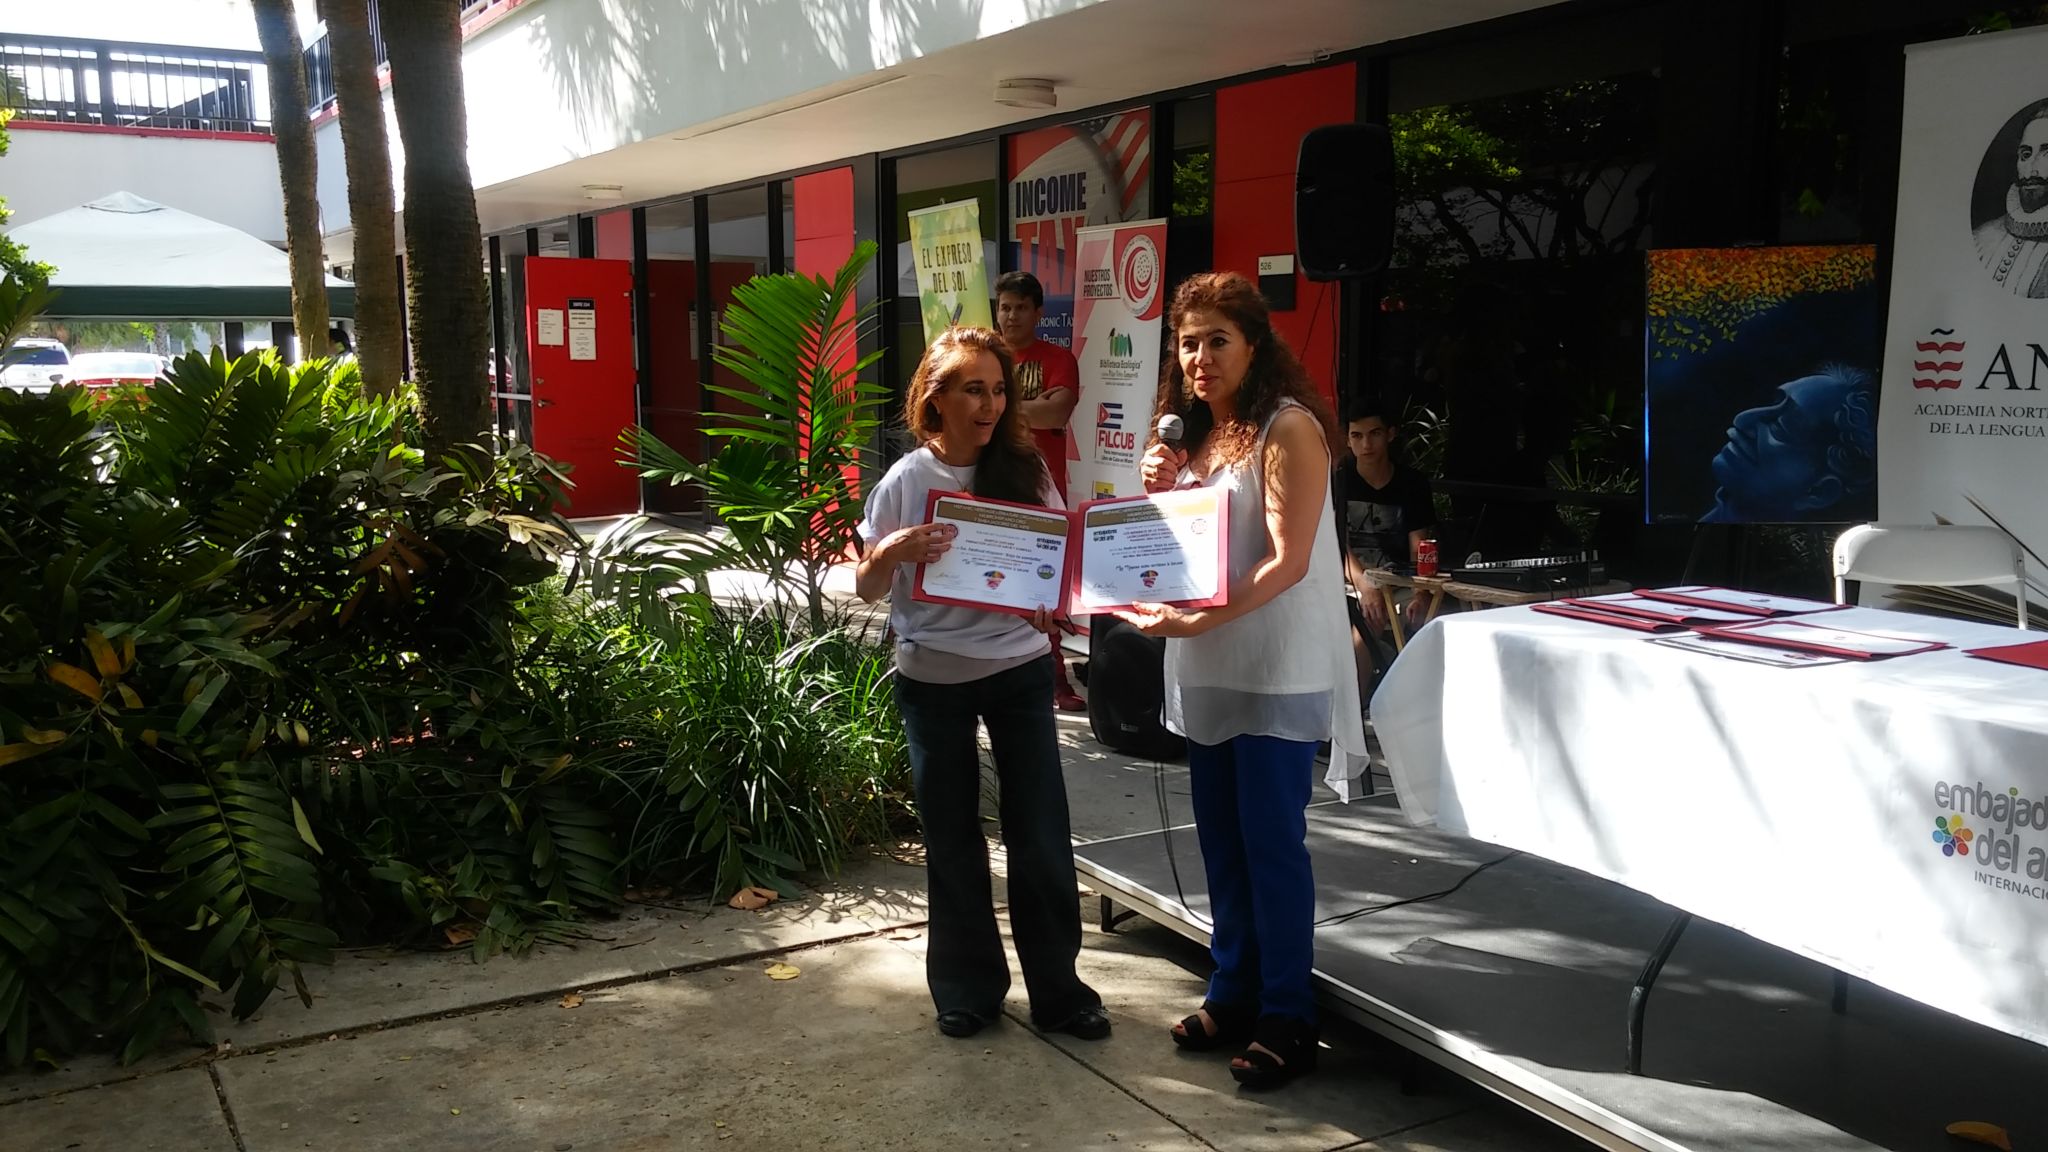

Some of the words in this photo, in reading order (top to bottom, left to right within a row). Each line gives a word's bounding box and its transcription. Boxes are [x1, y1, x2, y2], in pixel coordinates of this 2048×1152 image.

[1016, 172, 1087, 218] INCOME
[922, 248, 932, 269] EL
[935, 242, 972, 267] EXPRESO
[1084, 269, 1110, 282] NUESTROS
[1260, 261, 1272, 271] 526
[932, 272, 948, 293] DEL
[951, 270, 968, 292] SOL
[1083, 284, 1113, 297] PROYECTOS
[1914, 404, 1996, 418] ACADEMIA
[1930, 422, 1951, 434] DE
[1955, 423, 1975, 435] LA
[1979, 424, 2046, 438] LENGUA
[1098, 431, 1135, 450] FILCUB
[1975, 828, 2020, 874] del
[1974, 870, 2048, 900] INTERNACI
